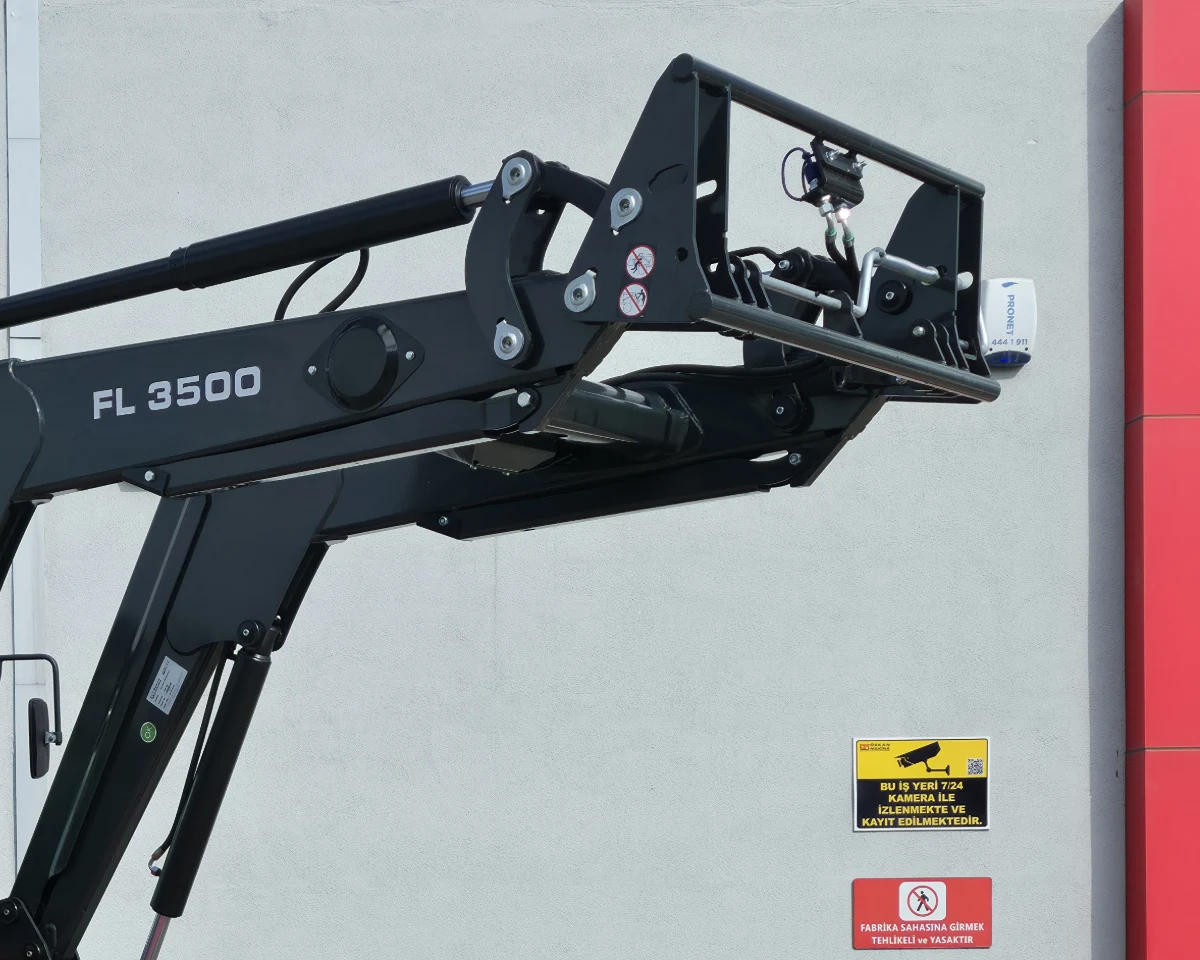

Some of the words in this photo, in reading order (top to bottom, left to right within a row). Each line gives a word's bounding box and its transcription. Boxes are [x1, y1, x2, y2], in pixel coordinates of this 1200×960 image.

[1006, 294, 1015, 335] PRONET
[991, 338, 1008, 346] 444
[1016, 338, 1028, 346] 911
[93, 387, 136, 420] FL
[147, 365, 262, 411] 3500
[880, 782, 896, 791] BU
[899, 780, 910, 792] İŞ
[912, 780, 938, 790] YERİ
[941, 781, 964, 790] 7/24
[888, 793, 935, 803] KAMERA
[938, 792, 955, 802] İLE
[878, 804, 948, 815] İZLENMEKTE
[950, 805, 966, 814] VE
[862, 817, 895, 827] KAYIT
[898, 815, 983, 826] EDİLMEKTEDİR.
[860, 921, 899, 932] FABRİKA
[900, 922, 947, 932] SAHASINA
[949, 921, 985, 931] GİRMEK
[871, 934, 916, 945] TEHLİKELİ
[930, 935, 974, 944] YASAKTIR
